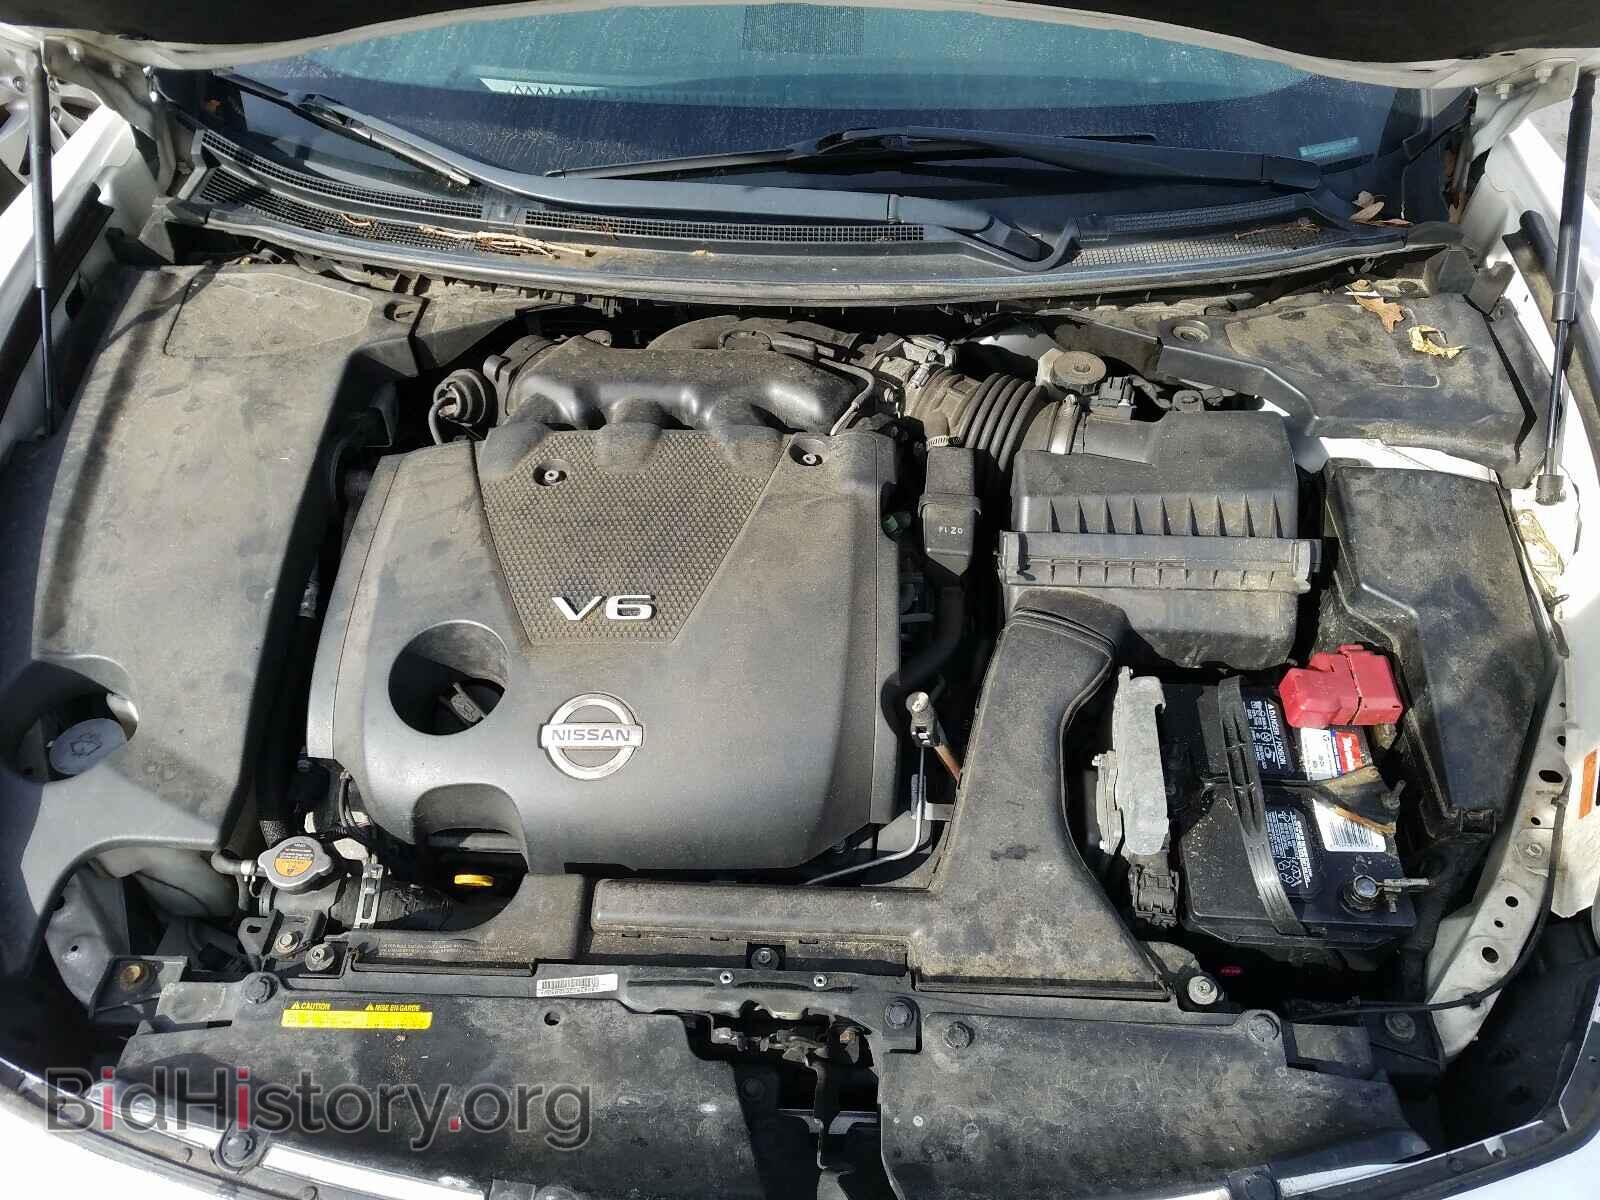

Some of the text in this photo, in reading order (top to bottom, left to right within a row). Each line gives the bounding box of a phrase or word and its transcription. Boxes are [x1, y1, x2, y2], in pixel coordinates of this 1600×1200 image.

[551, 594, 657, 621] V6
[551, 729, 631, 742] NISSAN
[1269, 709, 1280, 736] DANGER
[1276, 740, 1287, 765] POISON
[301, 1002, 331, 1010] CAUTION
